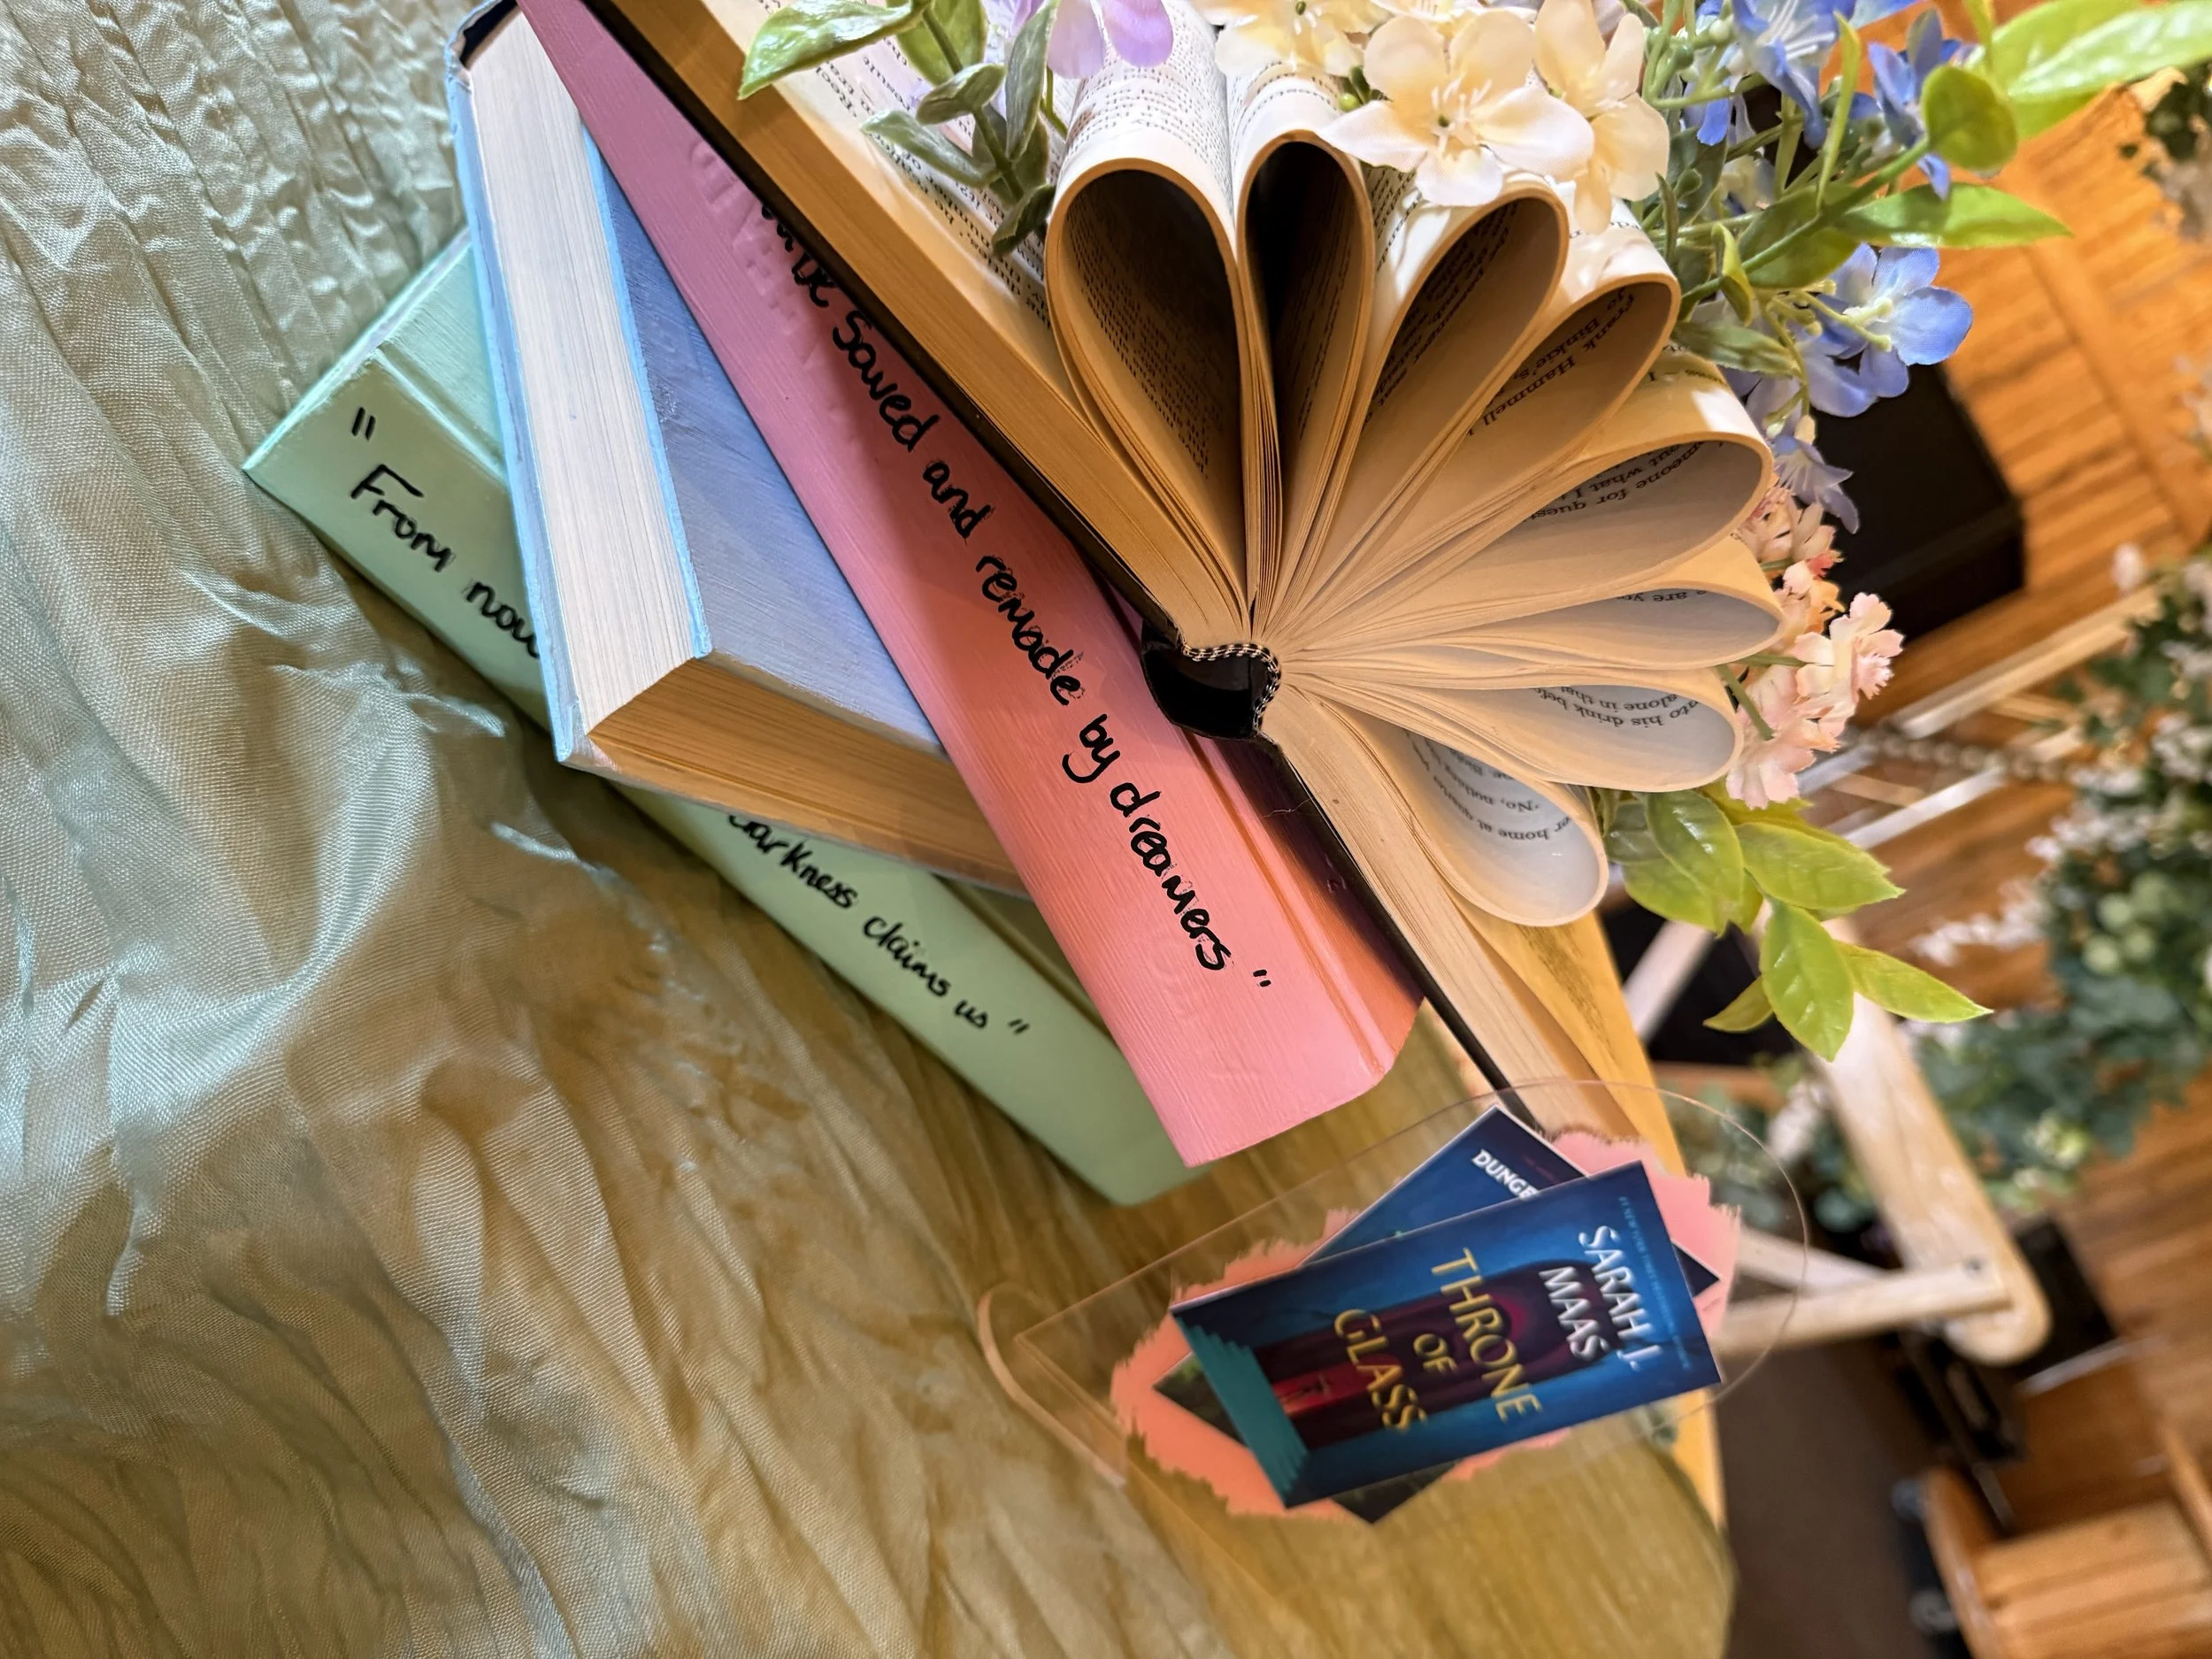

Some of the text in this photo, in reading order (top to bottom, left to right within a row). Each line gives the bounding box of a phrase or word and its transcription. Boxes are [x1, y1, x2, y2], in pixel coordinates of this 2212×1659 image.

[1513, 316, 1600, 381] Binkie's,
[1483, 356, 1577, 426] Hammell
[1589, 466, 1643, 493] what
[1596, 488, 1629, 506] for
[349, 464, 452, 572] From
[1652, 590, 1688, 603] are
[922, 460, 995, 541] and
[975, 555, 1086, 706] remade
[1062, 713, 1120, 784] by
[1110, 782, 1233, 971] dreamers
[1573, 702, 1625, 726] drink
[1598, 699, 1618, 713] in
[1623, 694, 1678, 710] alone
[1631, 715, 1664, 729] his
[1498, 828, 1549, 841] home
[862, 915, 952, 997] claims
[954, 999, 989, 1030] us
[1538, 1266, 1610, 1362] MAAS
[1578, 1225, 1663, 1371] SARAH J.
[1413, 1333, 1458, 1376] OF
[1430, 1247, 1543, 1423] THRONE
[1333, 1309, 1429, 1432] GLASS
